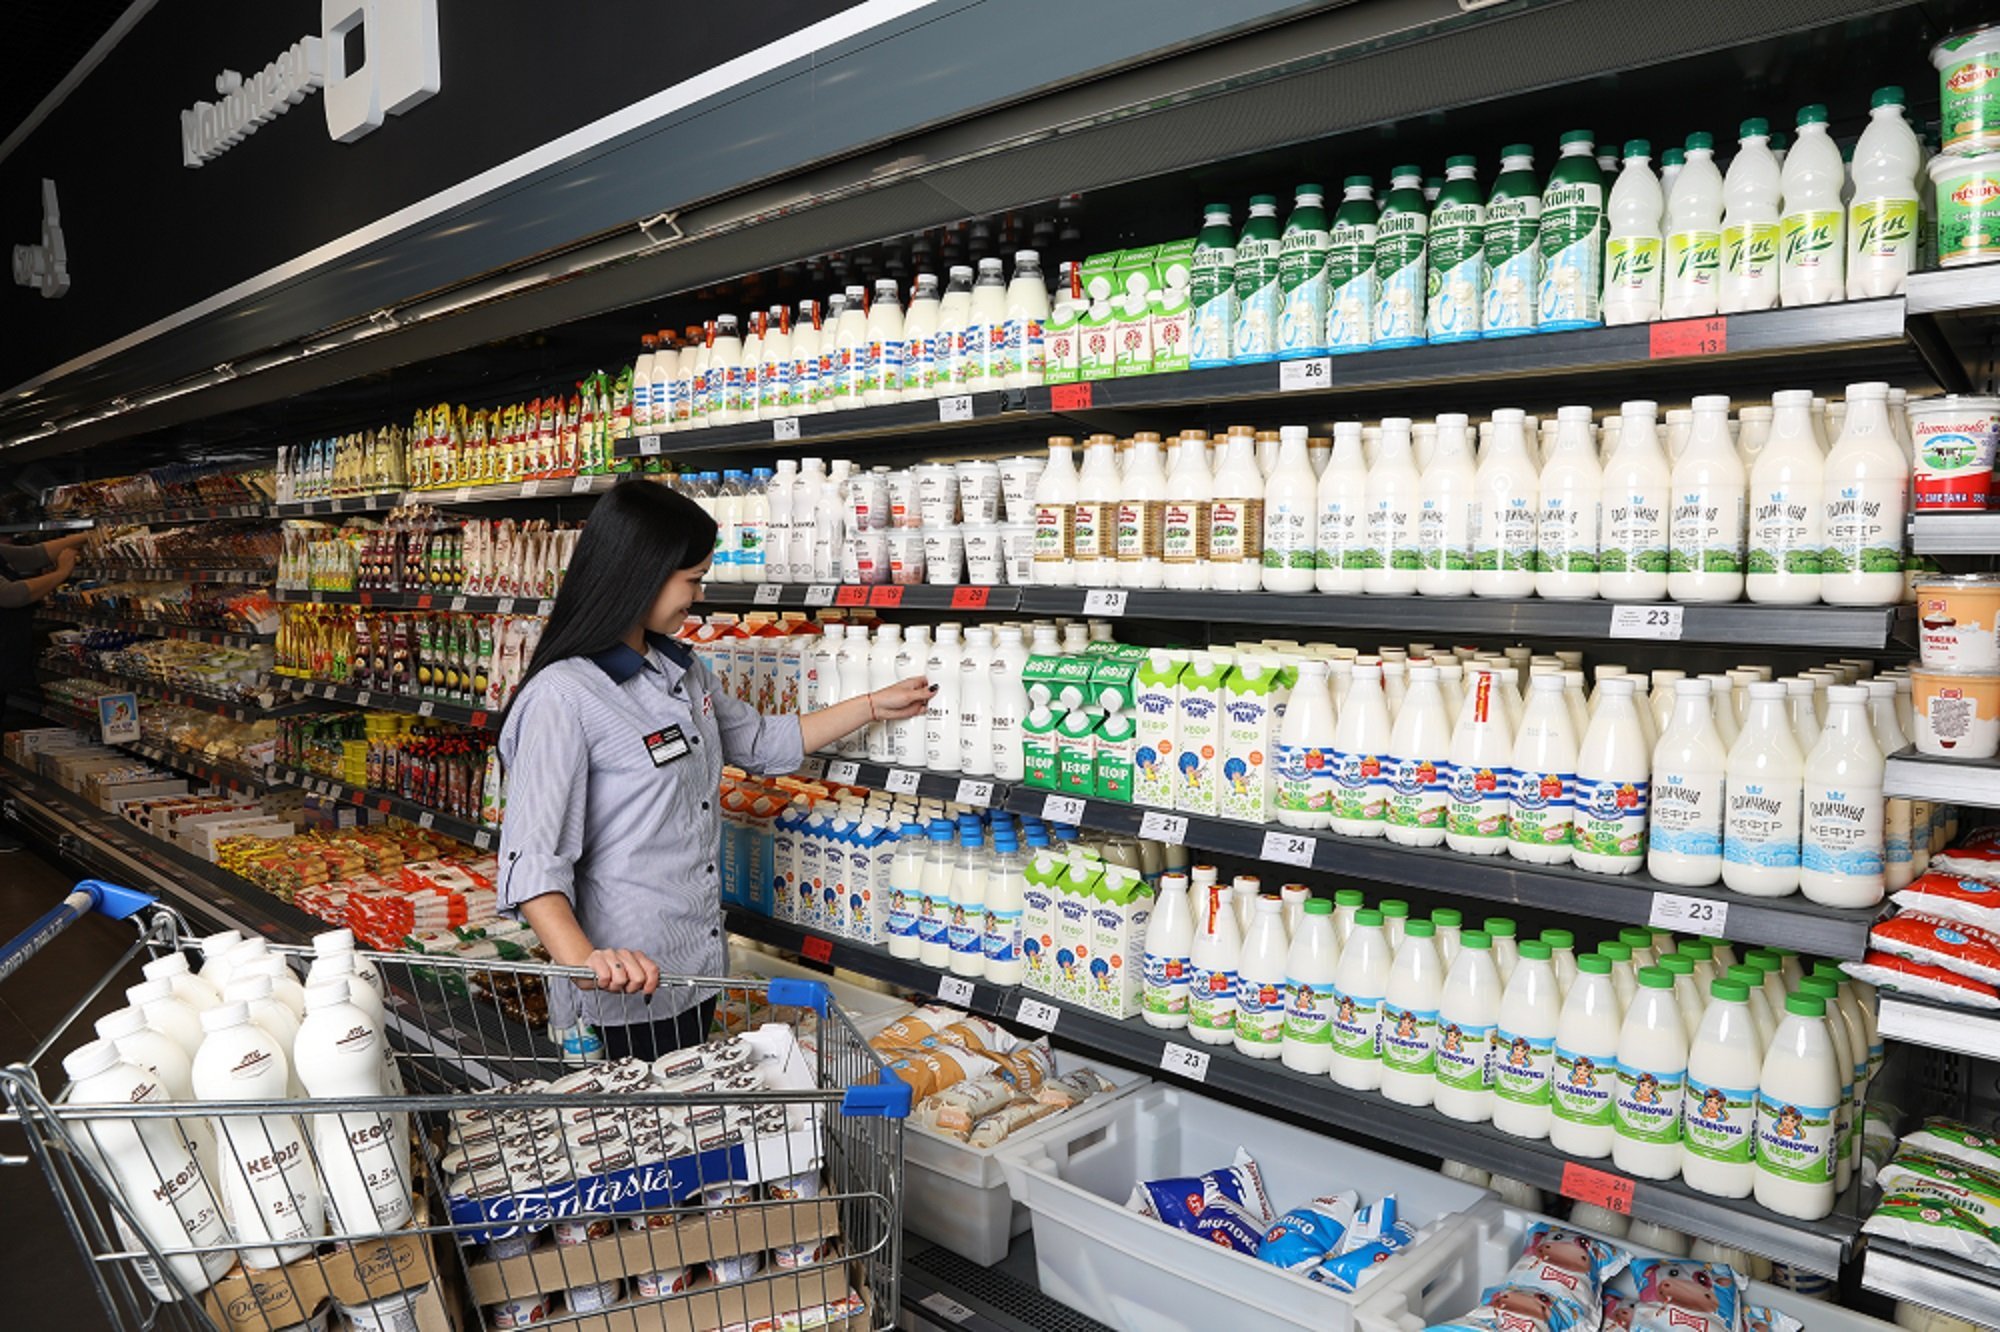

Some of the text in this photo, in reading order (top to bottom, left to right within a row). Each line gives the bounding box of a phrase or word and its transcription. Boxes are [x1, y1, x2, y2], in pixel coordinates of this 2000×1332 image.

[1700, 340, 1717, 353] 13
[1305, 363, 1323, 377] 26
[1104, 593, 1119, 608] 23
[1646, 610, 1670, 626] 23
[1025, 755, 1054, 769] КЕФІР
[1062, 761, 1091, 775] КЕФІР
[1099, 766, 1129, 780] КЕФІР
[975, 785, 987, 797] 22
[1064, 801, 1077, 815] 13
[1653, 806, 1702, 822] КЕФІР
[1163, 819, 1177, 832] 21
[1587, 820, 1624, 833] КЕФІР
[1729, 816, 1784, 833] КЕФІР
[1809, 825, 1868, 839] КЕФІР
[1288, 839, 1306, 853] 24
[1689, 902, 1714, 921] 23
[1037, 1007, 1050, 1020] 21
[1183, 1053, 1200, 1068] 23
[246, 1141, 300, 1175] КЕФІР
[484, 1165, 683, 1241] Fantasia
[1605, 1196, 1623, 1211] 18
